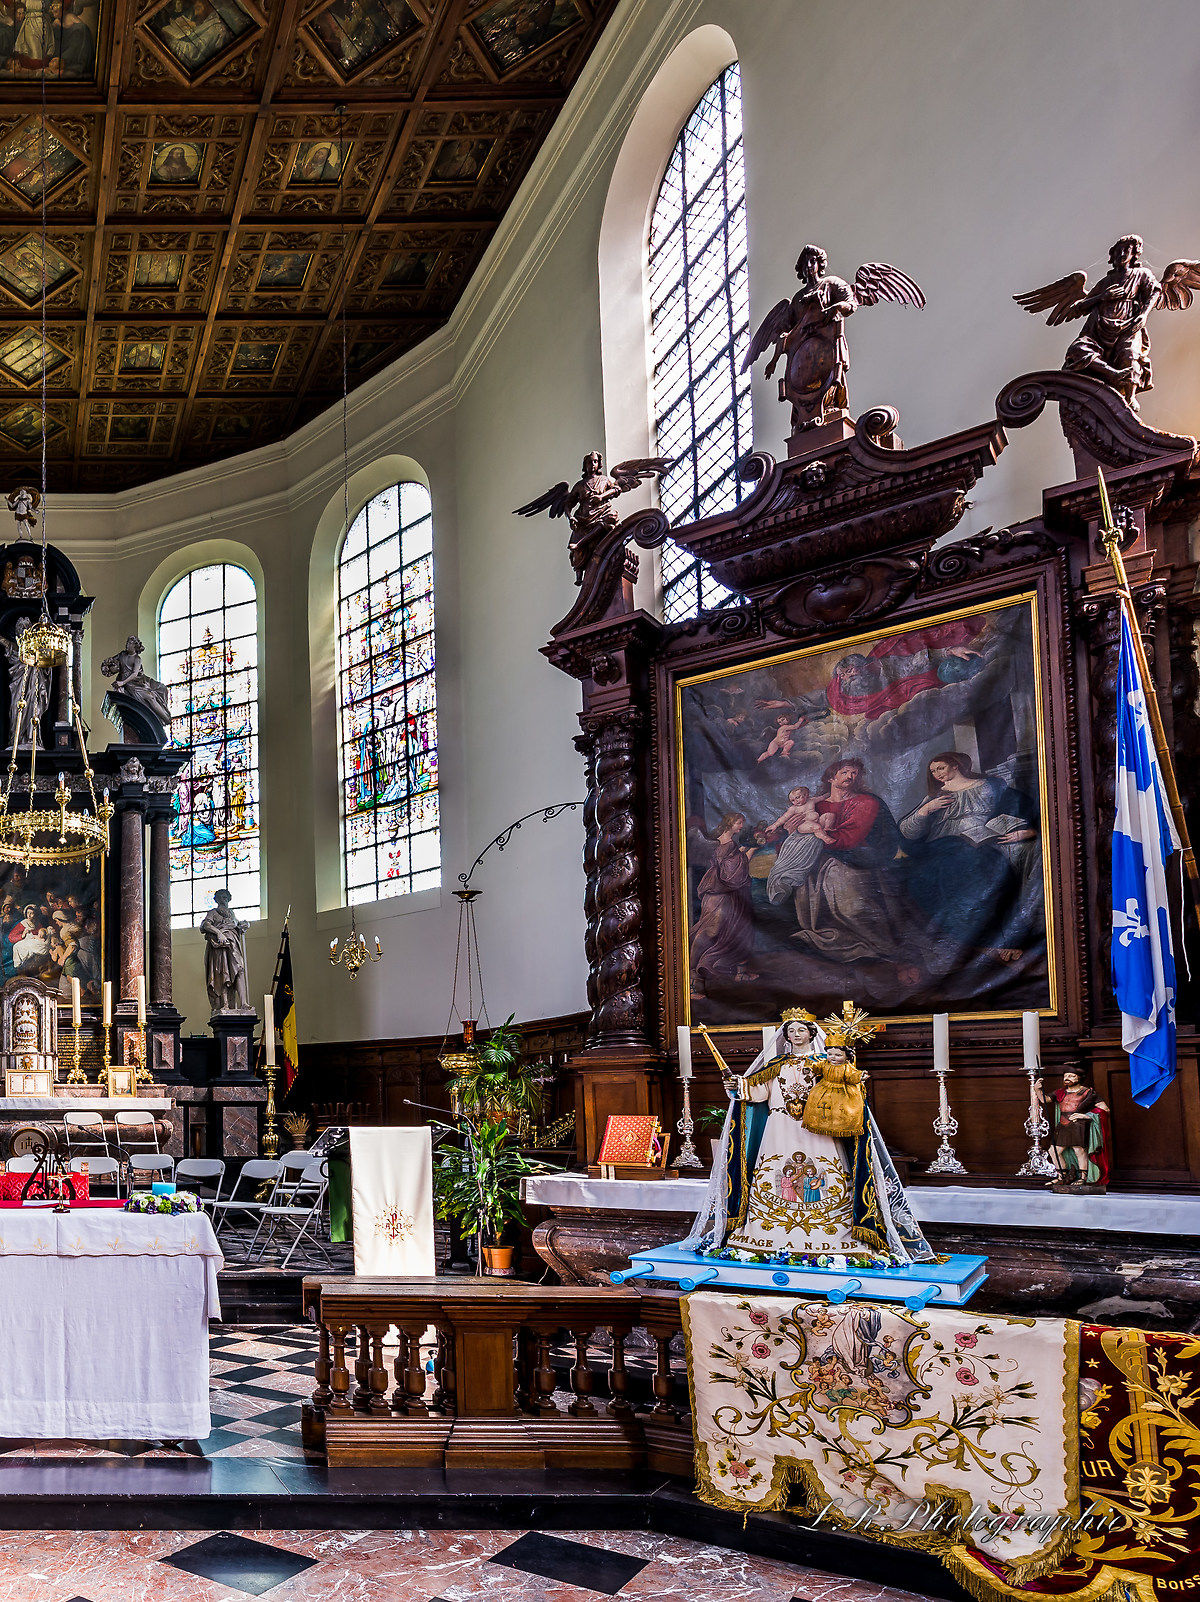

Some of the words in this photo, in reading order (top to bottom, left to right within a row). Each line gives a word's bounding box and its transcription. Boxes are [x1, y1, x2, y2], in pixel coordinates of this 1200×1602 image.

[763, 1193, 792, 1208] SALVE
[797, 1198, 837, 1210] REGINA
[786, 1241, 794, 1249] A
[841, 1241, 858, 1250] DE
[1081, 1459, 1116, 1478] UR
